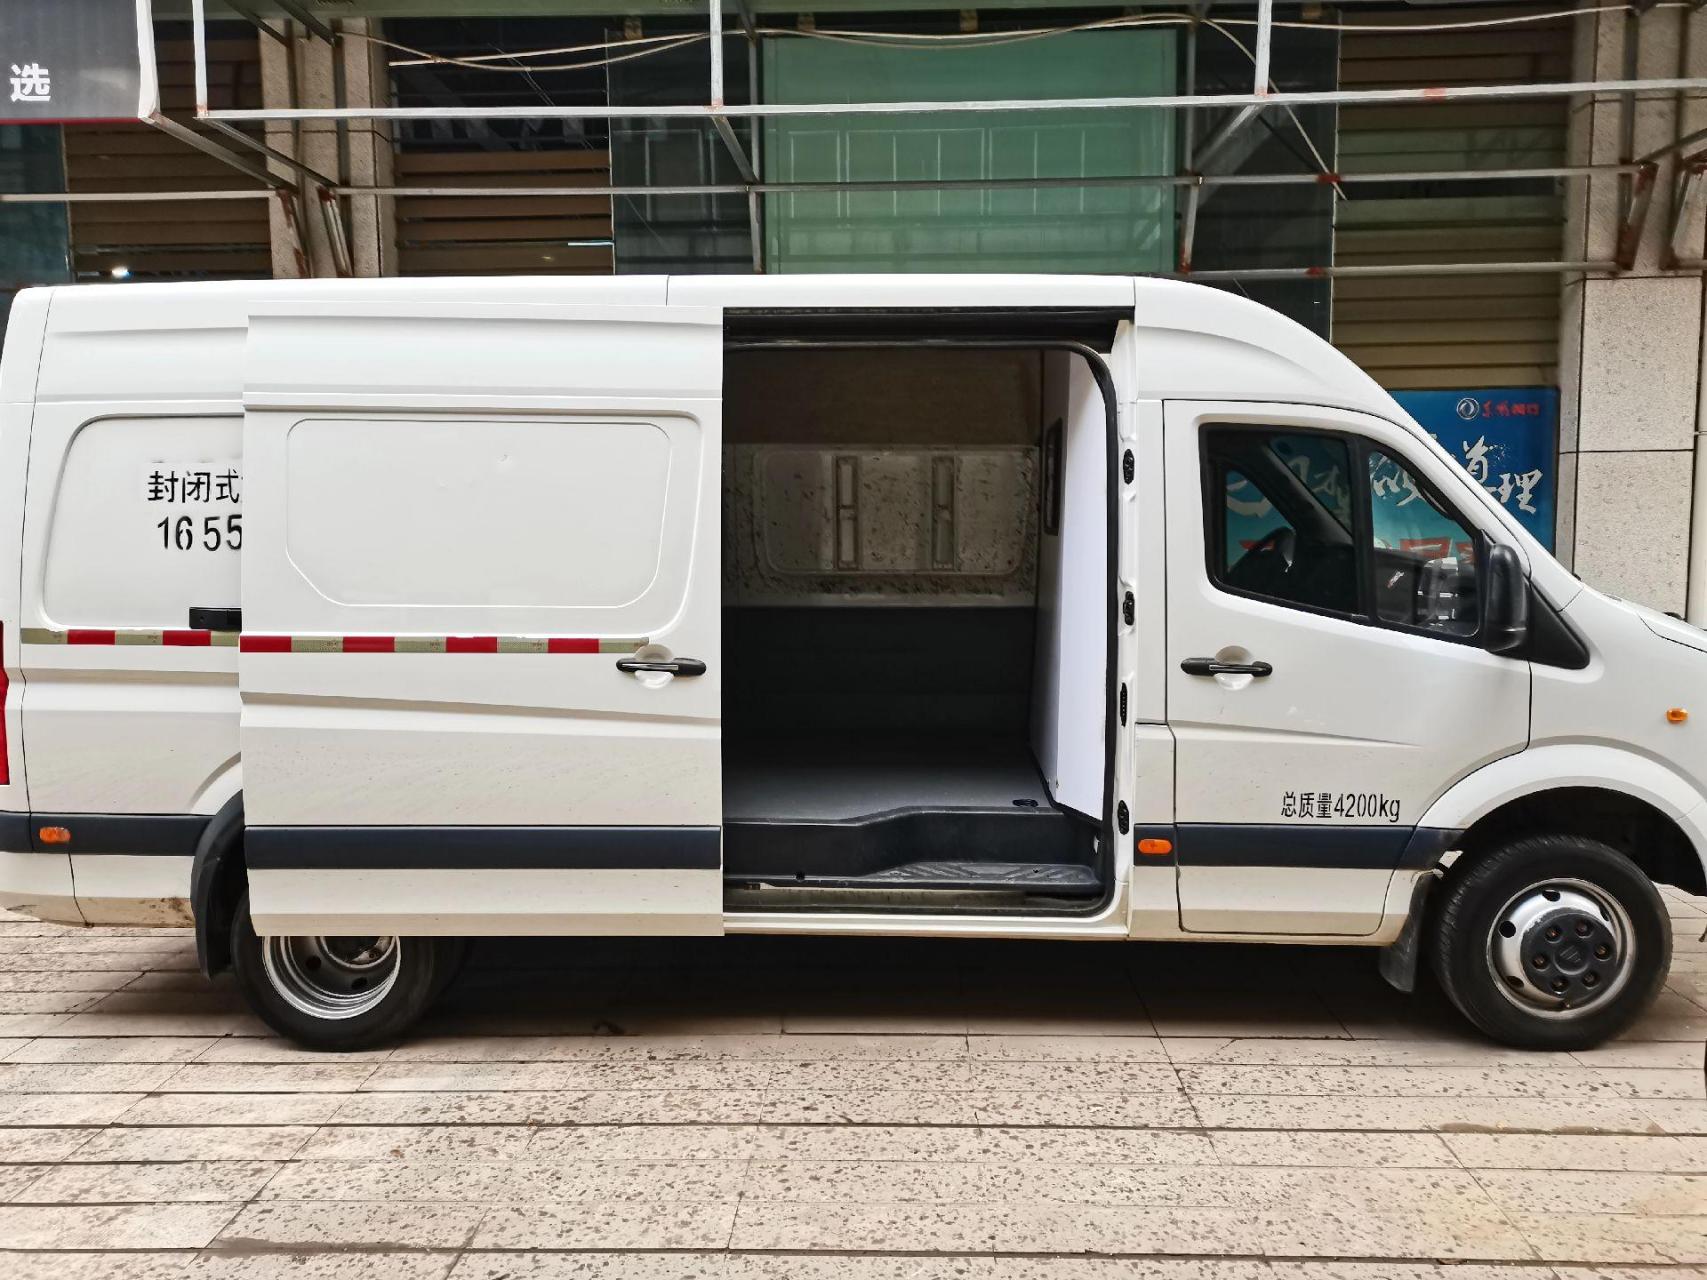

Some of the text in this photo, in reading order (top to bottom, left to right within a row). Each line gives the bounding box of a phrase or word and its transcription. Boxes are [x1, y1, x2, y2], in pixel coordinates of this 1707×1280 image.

[10, 62, 51, 102] 选
[147, 468, 243, 504] 封闭式
[1281, 791, 1400, 823] 总质量4200kg
